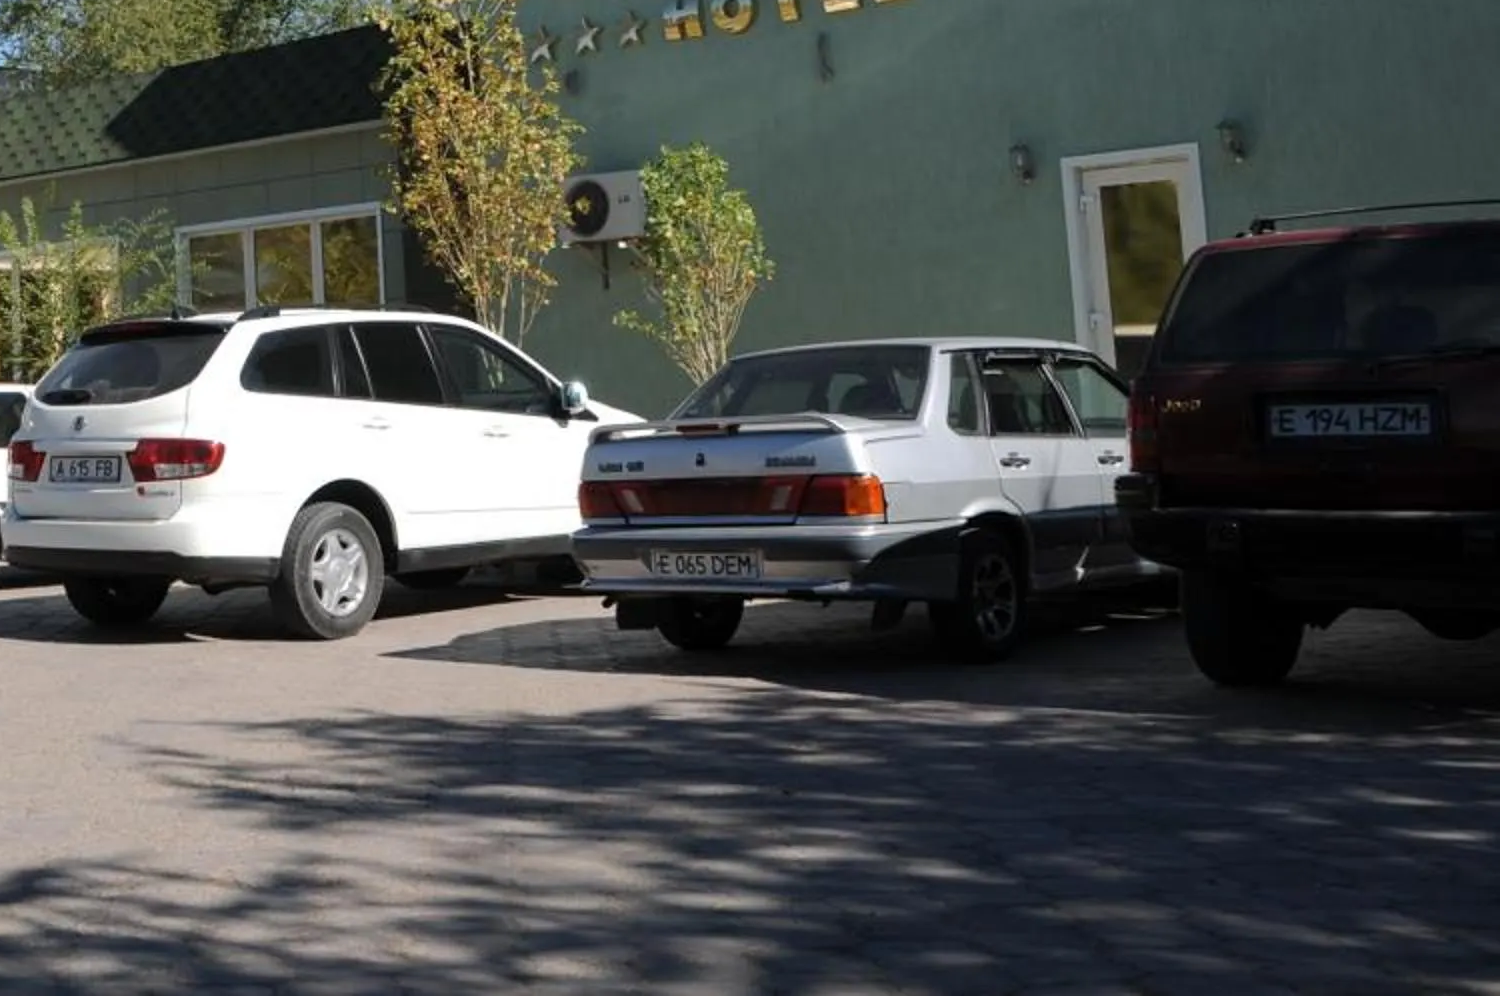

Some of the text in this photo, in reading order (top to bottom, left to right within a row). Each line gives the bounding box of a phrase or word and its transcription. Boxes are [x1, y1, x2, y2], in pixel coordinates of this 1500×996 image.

[1277, 406, 1422, 434] E 194 HZM
[658, 555, 752, 575] E 065 DEM
